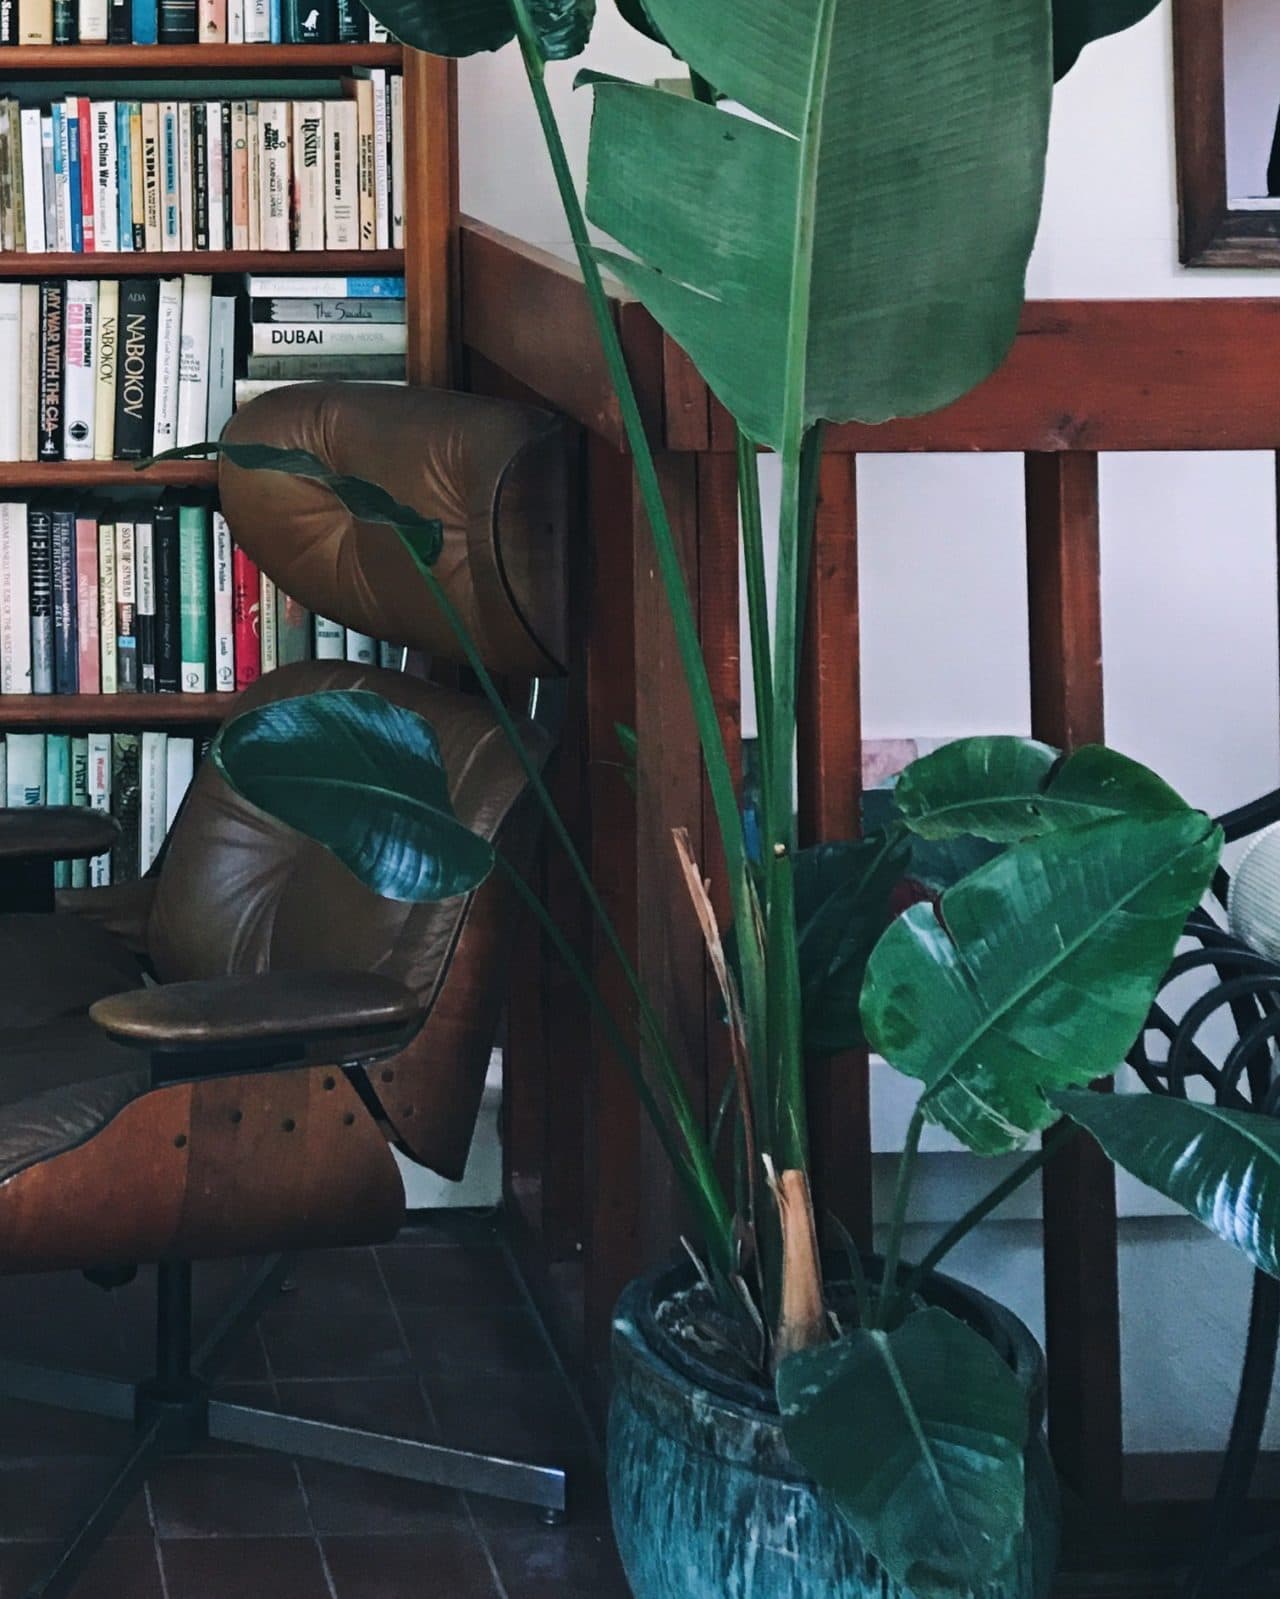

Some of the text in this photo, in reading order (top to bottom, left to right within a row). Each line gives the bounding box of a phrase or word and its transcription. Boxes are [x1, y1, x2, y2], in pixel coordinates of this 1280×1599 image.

[98, 111, 109, 188] India's China War
[146, 137, 157, 189] INDIA
[67, 303, 83, 368] CIA DIARY
[84, 303, 92, 324] INSIDE
[271, 329, 323, 344] DUBAI
[47, 287, 61, 432] MY WAR WITH THE CIA
[84, 338, 92, 368] COMPANY
[100, 316, 115, 385] NABOKOV
[123, 313, 146, 419] NABOKOV
[53, 521, 61, 591] INHERITANCE
